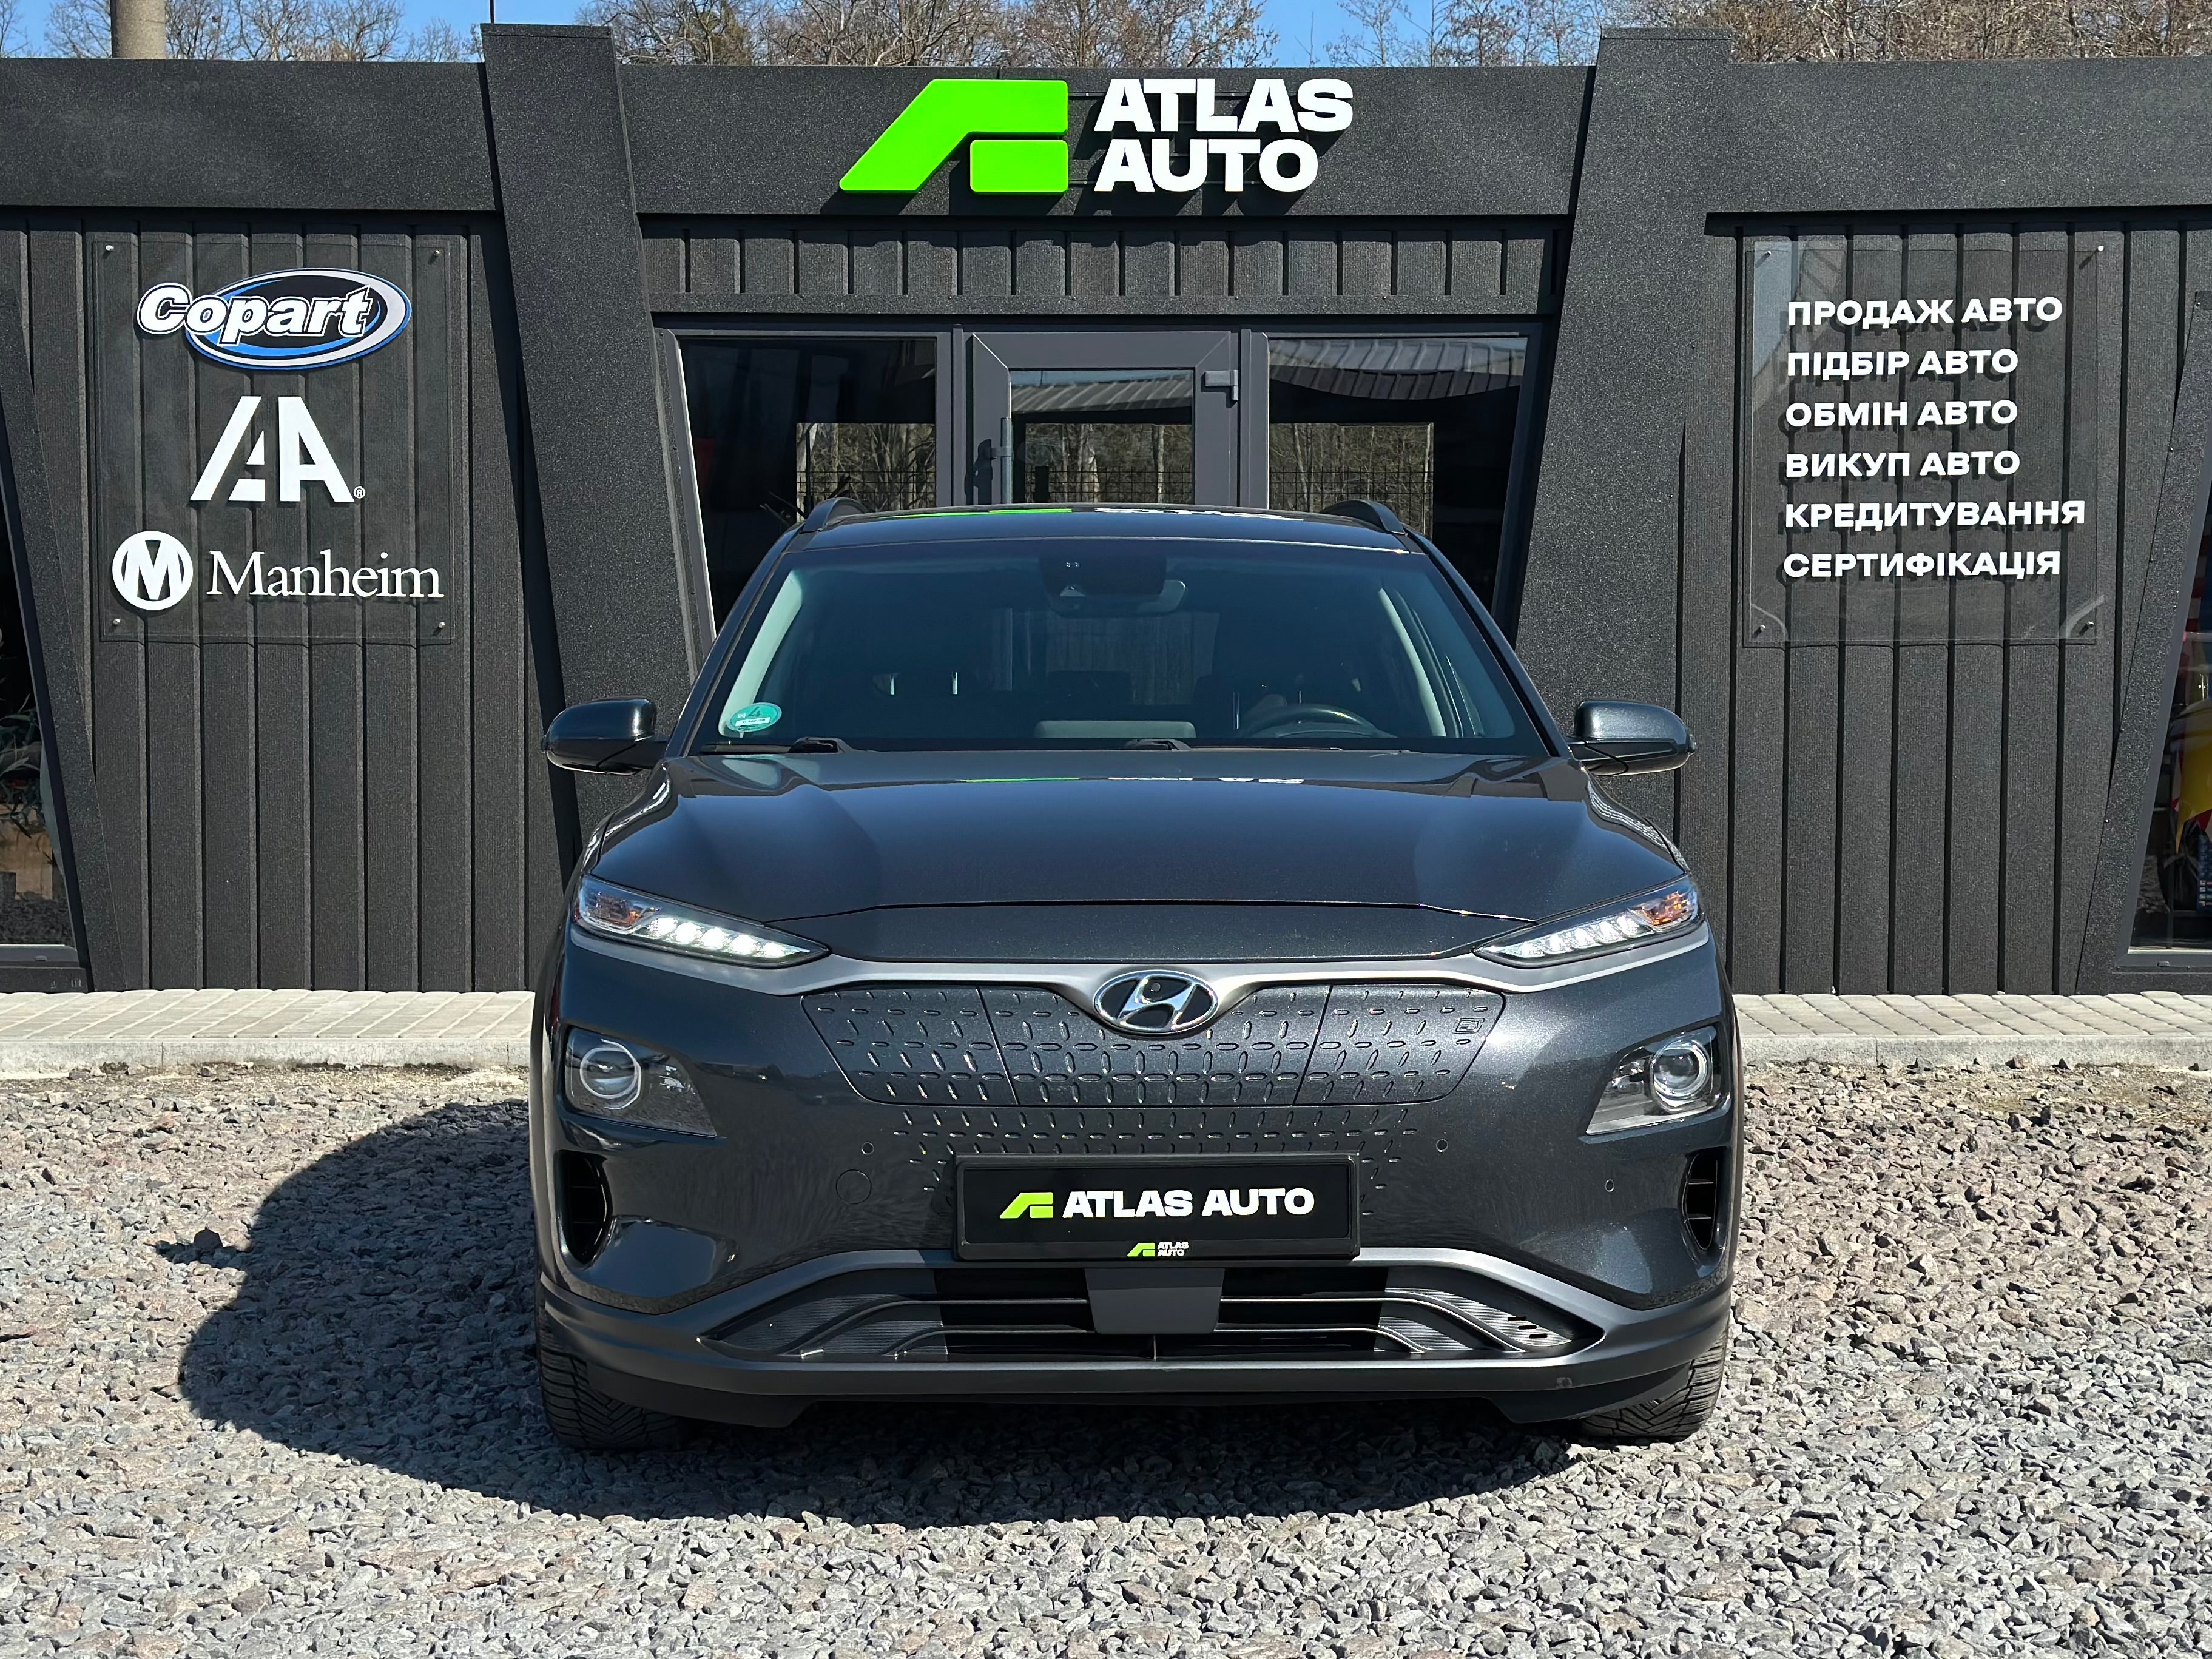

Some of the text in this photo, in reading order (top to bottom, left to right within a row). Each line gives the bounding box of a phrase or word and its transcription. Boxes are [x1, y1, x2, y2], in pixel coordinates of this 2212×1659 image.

[1094, 78, 1354, 132] ATLAS
[1094, 138, 1318, 192] AUTO
[137, 282, 374, 346] Copart
[1788, 297, 2063, 329] ПРОДАЖ АВТО
[1787, 349, 2018, 380] ПІДБІР АВТО
[1785, 399, 2018, 427] ОБМІН АВТО
[1786, 450, 2020, 477] ВИКУП АВТО
[1785, 500, 2085, 531] КРЕДИТУВАННЯ
[207, 548, 445, 597] Manheim
[1784, 551, 2060, 580] СЕРТИФІКАЦІЯ
[1063, 1188, 1315, 1219] ATLAS AUTO
